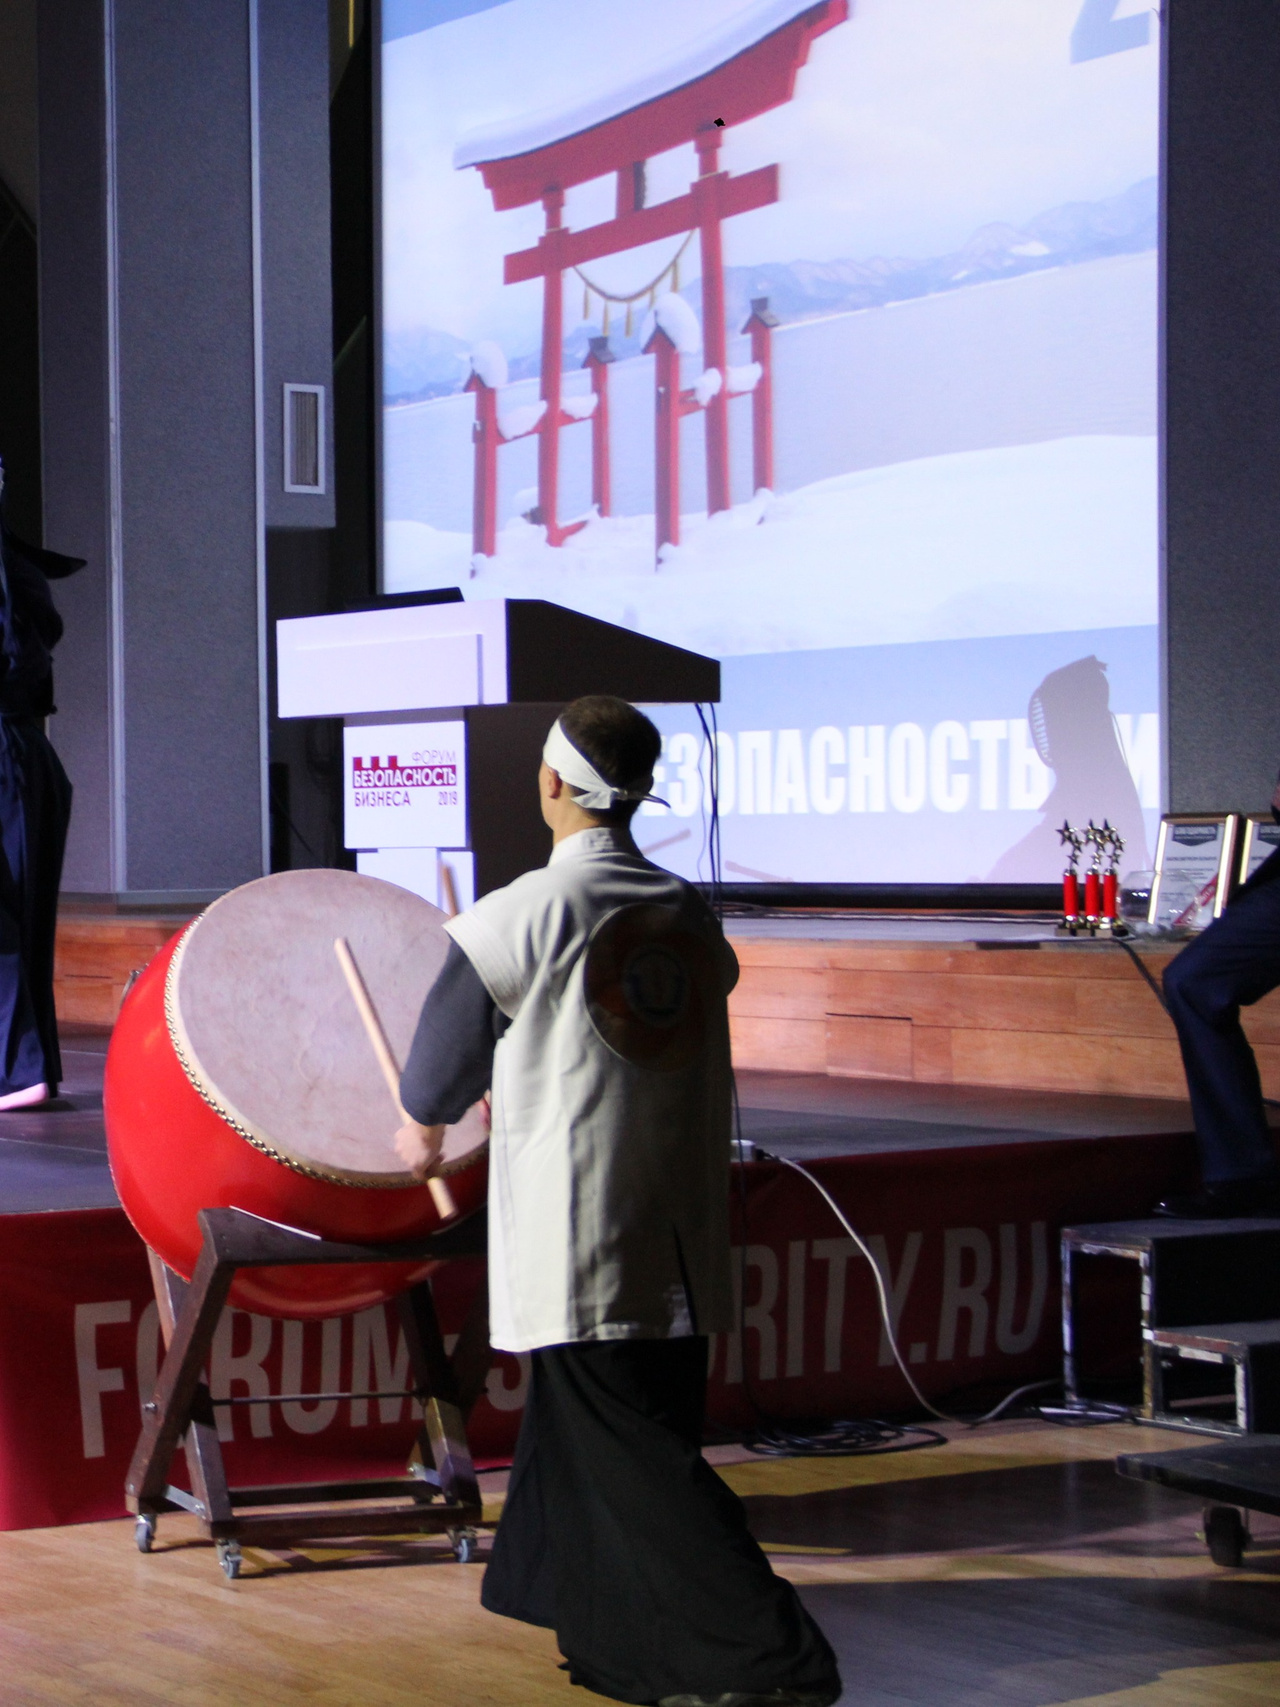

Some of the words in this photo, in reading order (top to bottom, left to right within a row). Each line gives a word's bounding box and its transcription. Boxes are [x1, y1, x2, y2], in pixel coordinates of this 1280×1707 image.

[412, 749, 456, 764] ФОРУМ
[353, 767, 457, 788] БЕЗОПАСНОСТЬ
[355, 790, 411, 808] БИЗНЕСА
